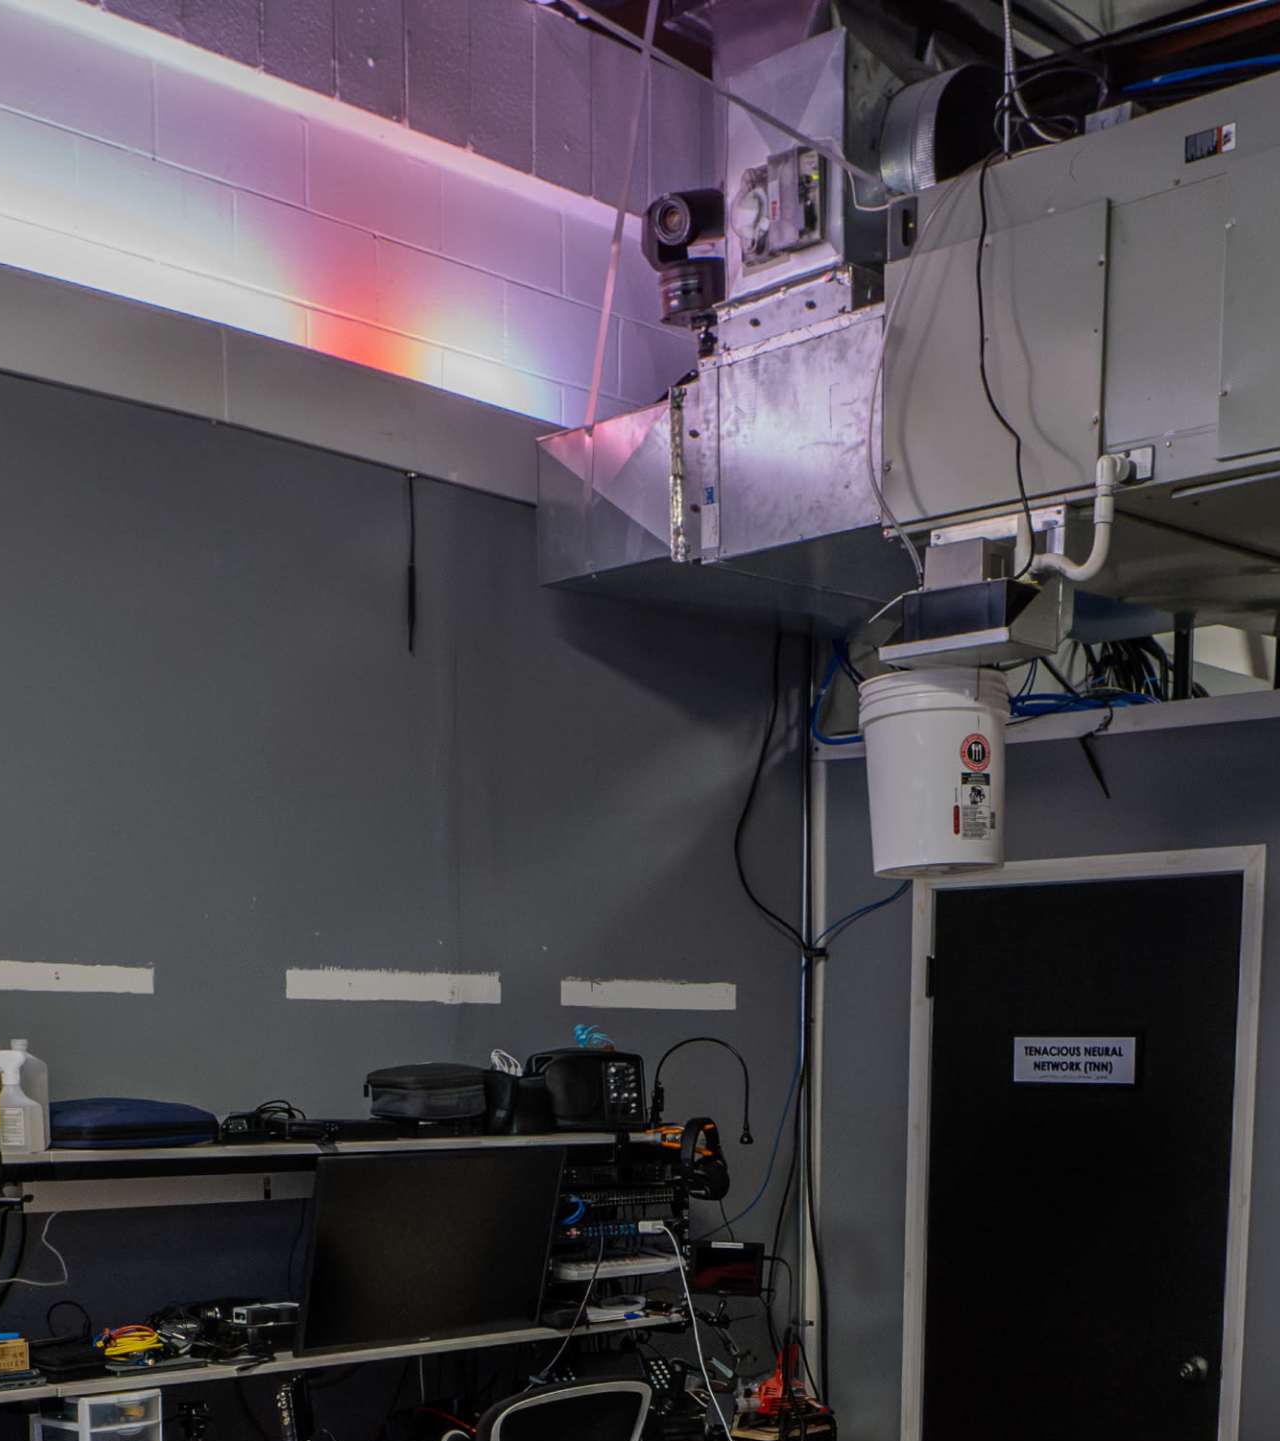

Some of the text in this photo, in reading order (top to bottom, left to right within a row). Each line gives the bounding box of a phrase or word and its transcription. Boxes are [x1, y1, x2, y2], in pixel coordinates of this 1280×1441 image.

[1024, 1045, 1124, 1057] TENACIOUS NEURAL
[1033, 1061, 1113, 1075] NETWORK (TNN)
